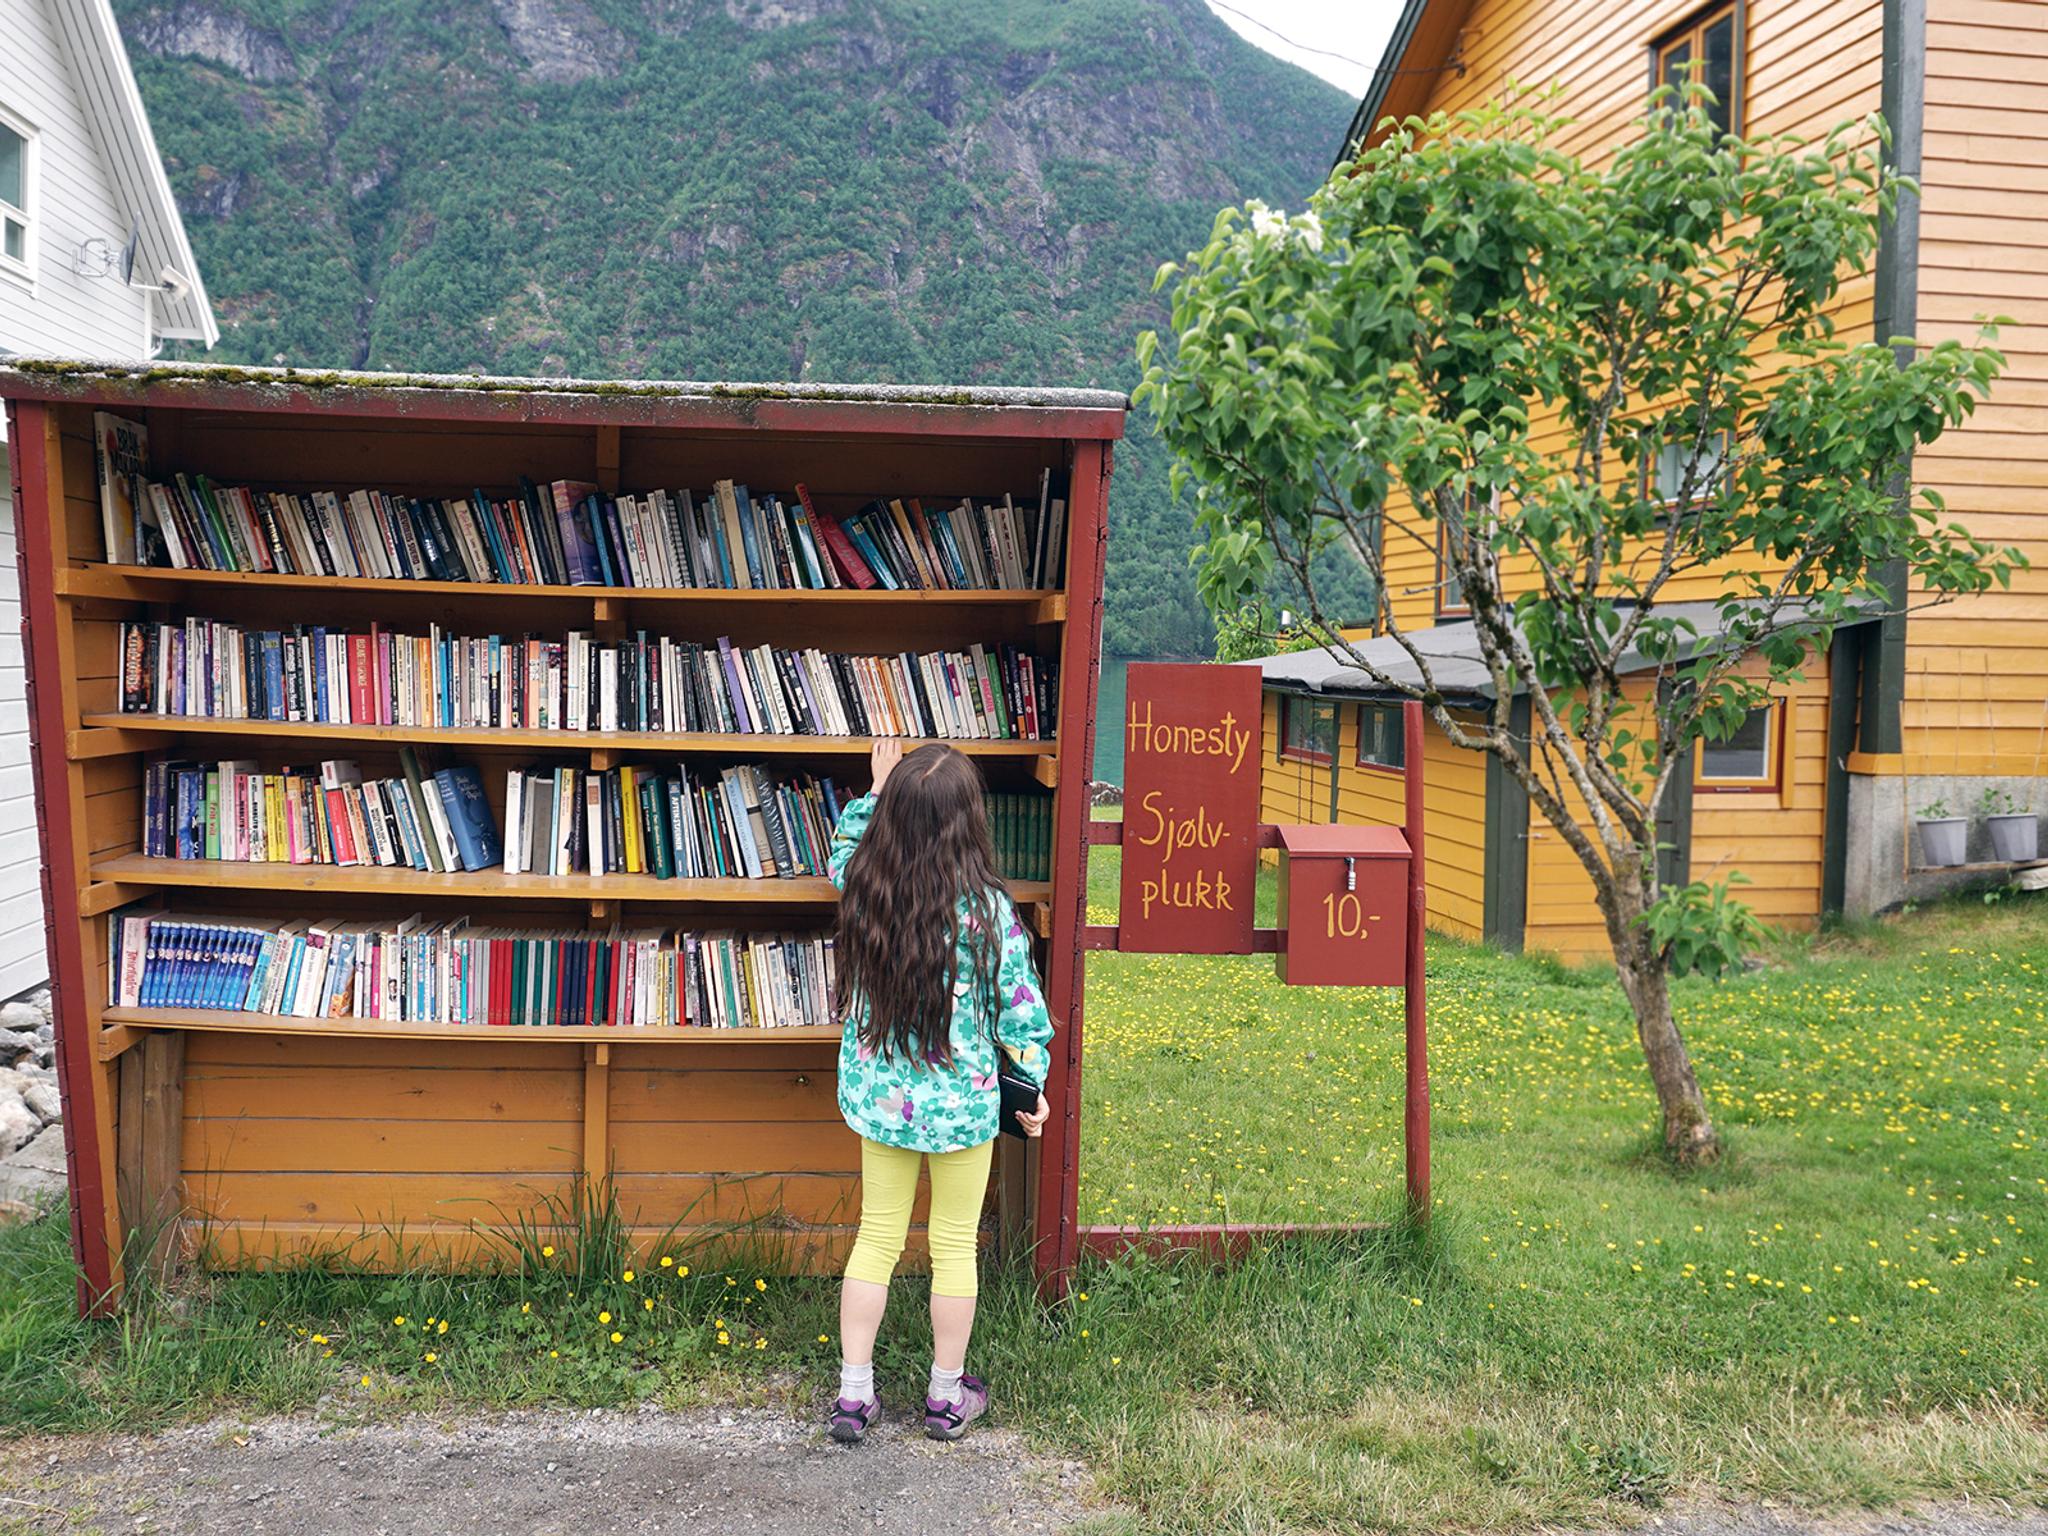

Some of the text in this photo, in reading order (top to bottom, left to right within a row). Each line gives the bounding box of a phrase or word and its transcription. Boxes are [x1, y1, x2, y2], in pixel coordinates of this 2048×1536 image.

[1128, 701, 1250, 774] Honesty
[1139, 791, 1231, 863] Sjølv-
[1141, 869, 1233, 919] plukk
[1323, 892, 1381, 939] 10,-
